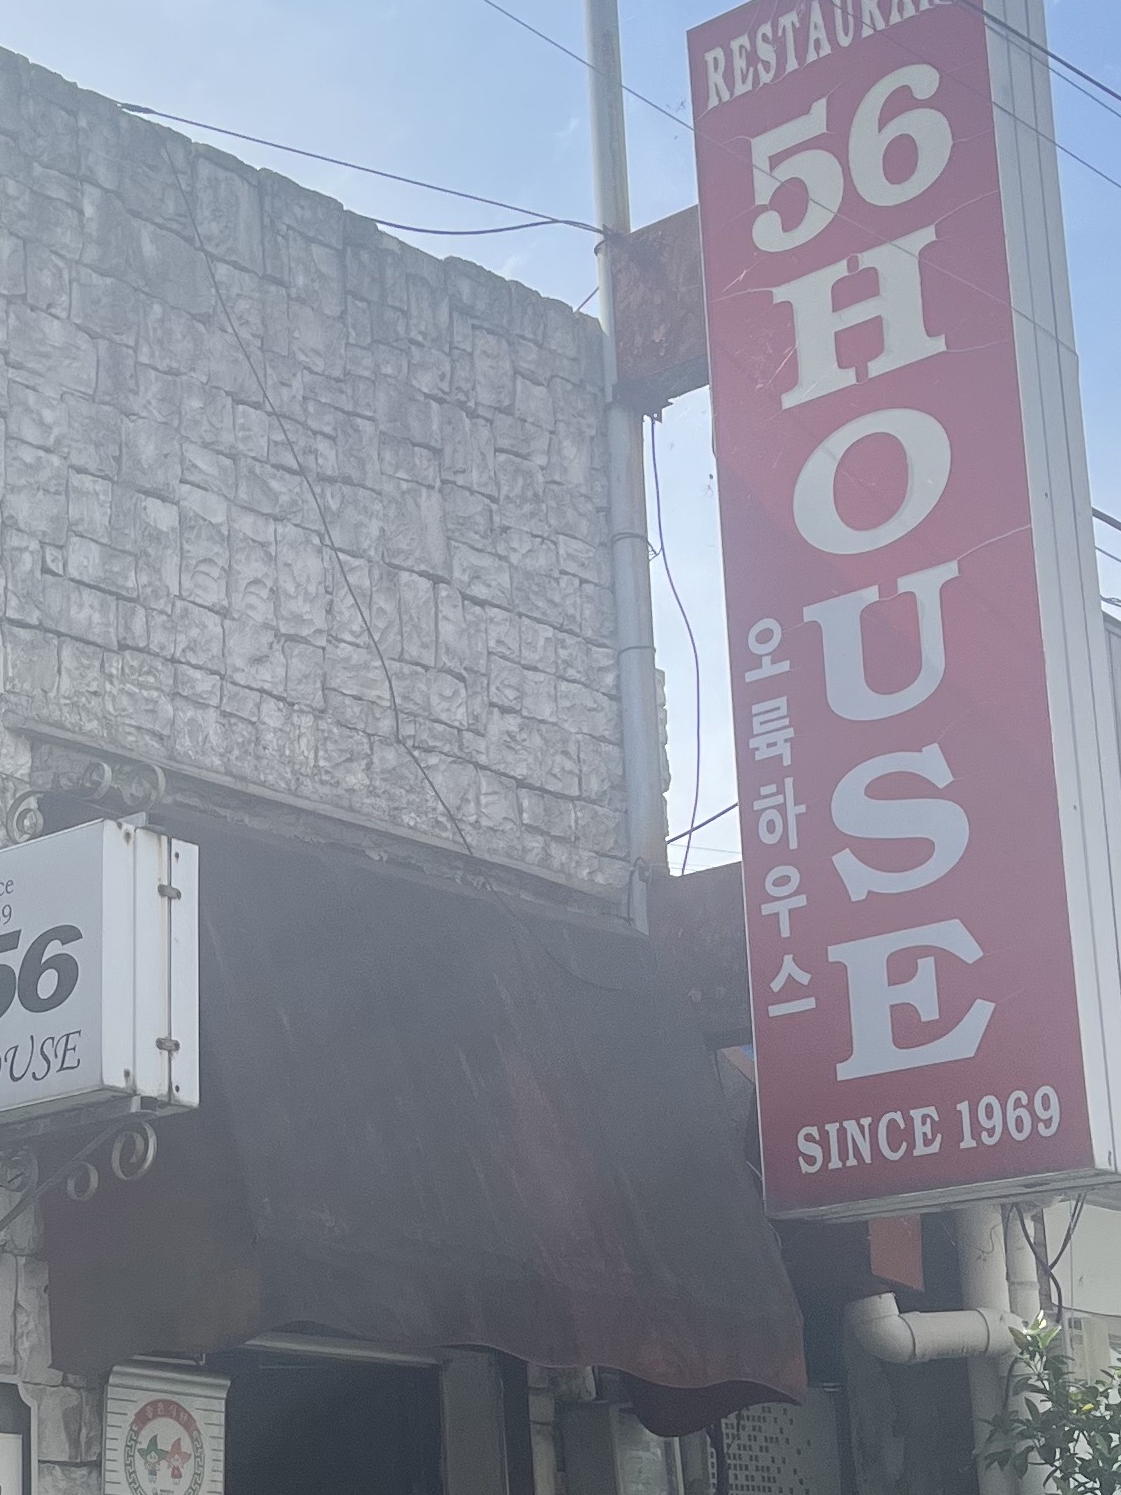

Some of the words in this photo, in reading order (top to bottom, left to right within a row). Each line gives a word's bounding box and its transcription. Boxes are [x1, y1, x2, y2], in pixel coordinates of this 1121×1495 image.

[704, 0, 954, 110] RESTAUR
[751, 63, 953, 252] 56
[773, 225, 996, 1081] HOUSE
[744, 618, 816, 1017] 오륙하우스
[797, 1106, 943, 1174] SINCE
[958, 1085, 1060, 1150] 1969
